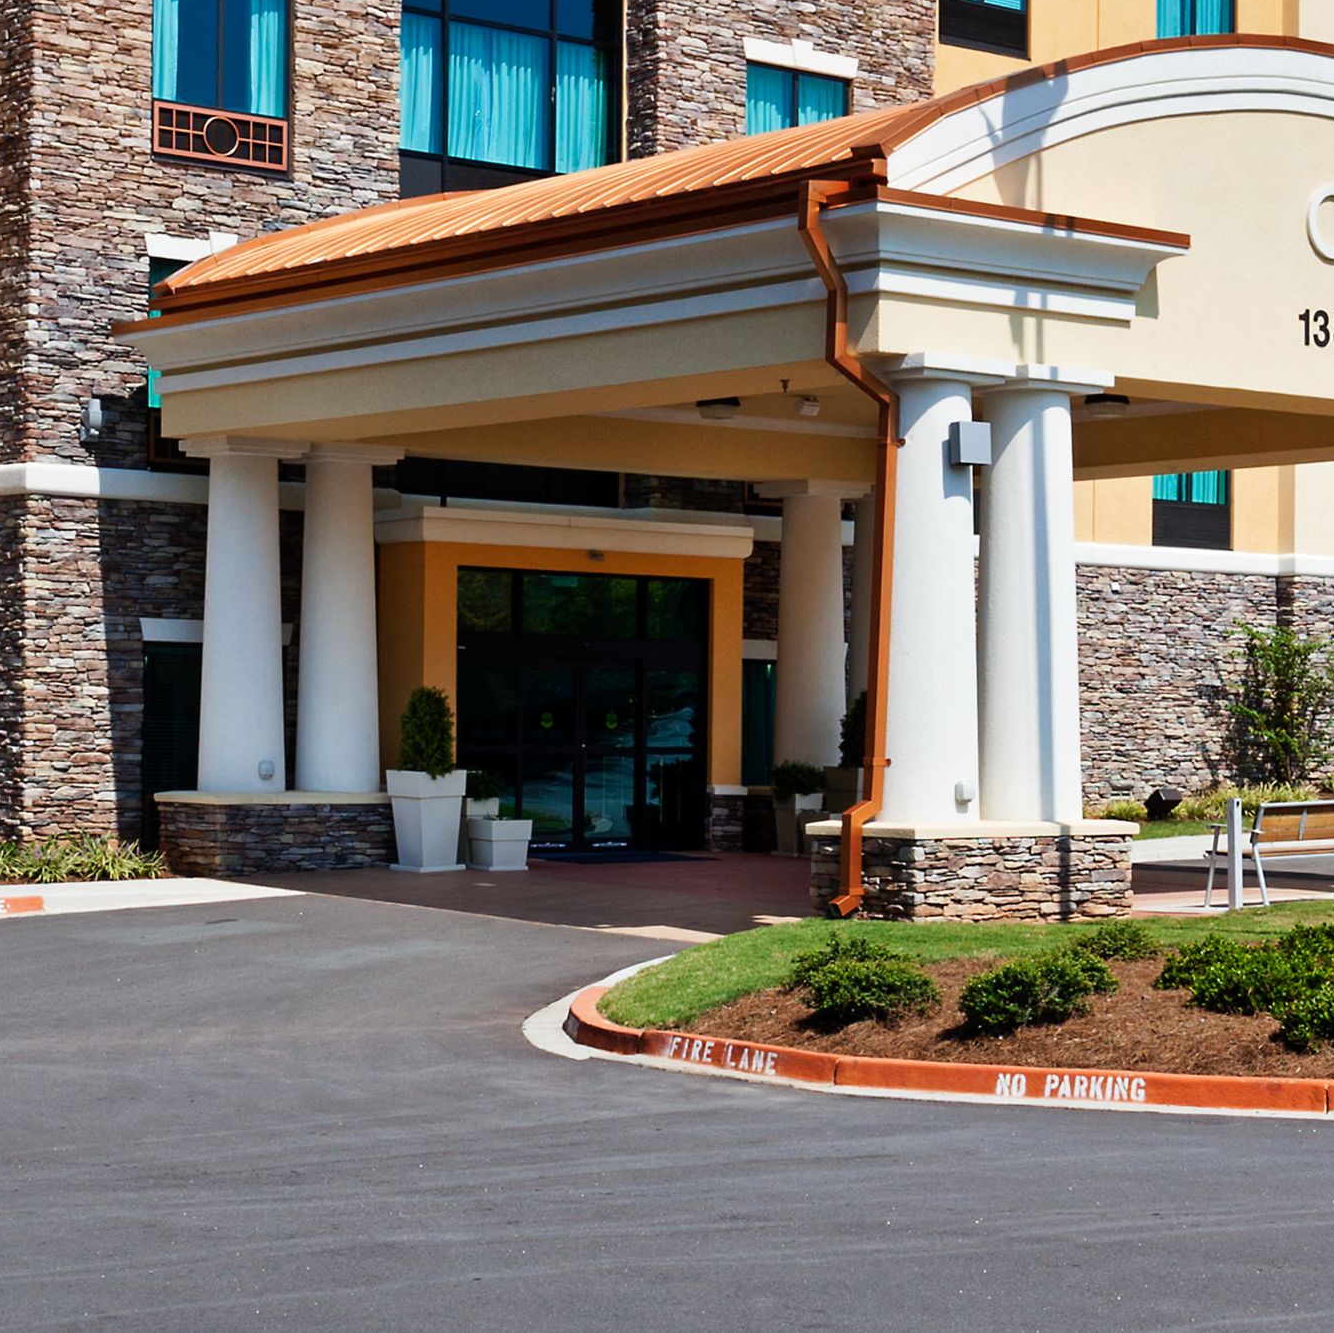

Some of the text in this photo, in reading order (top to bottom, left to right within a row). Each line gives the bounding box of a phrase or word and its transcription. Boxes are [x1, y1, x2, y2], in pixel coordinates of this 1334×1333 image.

[669, 1036, 779, 1076] FIRE LANE
[995, 1073, 1147, 1103] NO PARKING
